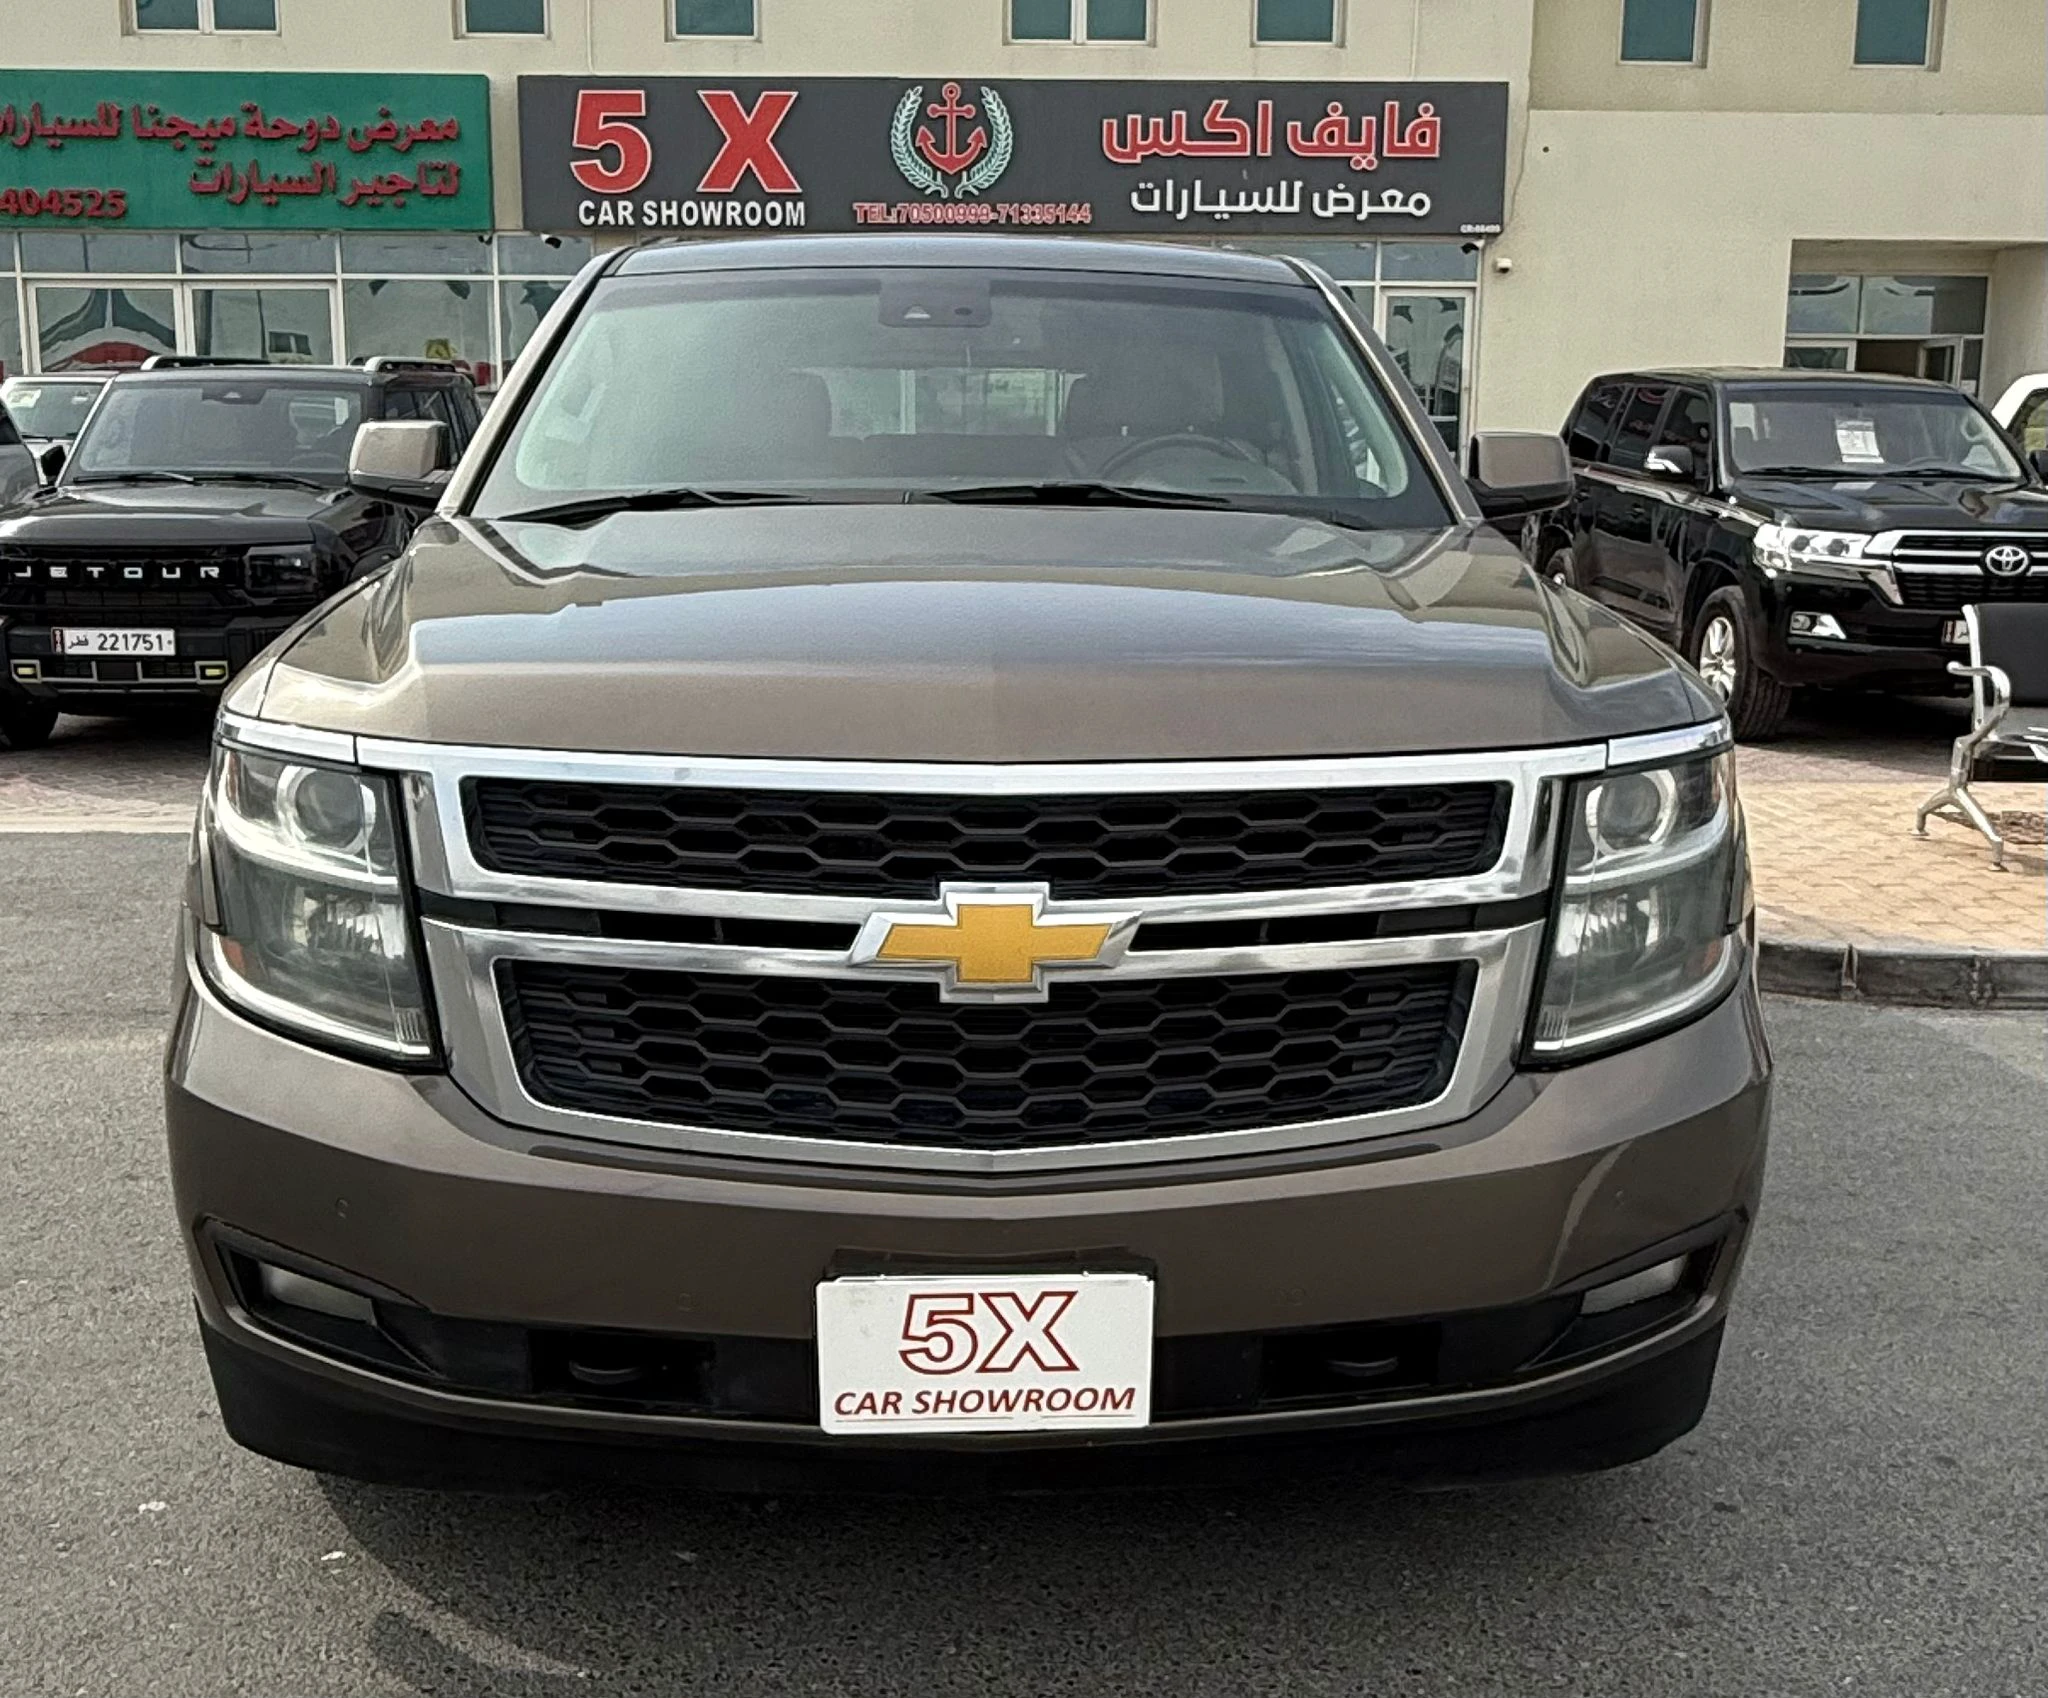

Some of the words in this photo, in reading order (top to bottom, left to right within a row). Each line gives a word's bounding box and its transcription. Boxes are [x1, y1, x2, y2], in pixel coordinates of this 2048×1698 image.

[241, 101, 340, 152] دوحة
[347, 105, 459, 152] معرض
[570, 89, 652, 194] 5
[696, 90, 802, 193] X
[1102, 99, 1273, 163] اكس
[1286, 100, 1441, 170] فايف
[190, 156, 336, 205] السيارات
[1130, 178, 1303, 220] للسيارات
[1312, 182, 1431, 221] معرض
[578, 199, 635, 227] CAR
[641, 199, 806, 228] SHOWROOM
[14, 565, 220, 579] JETOUR
[97, 633, 163, 651] 221751
[898, 1290, 1080, 1375] 5X
[834, 1391, 902, 1416] CAR
[912, 1387, 1136, 1414] SHOWROOM
